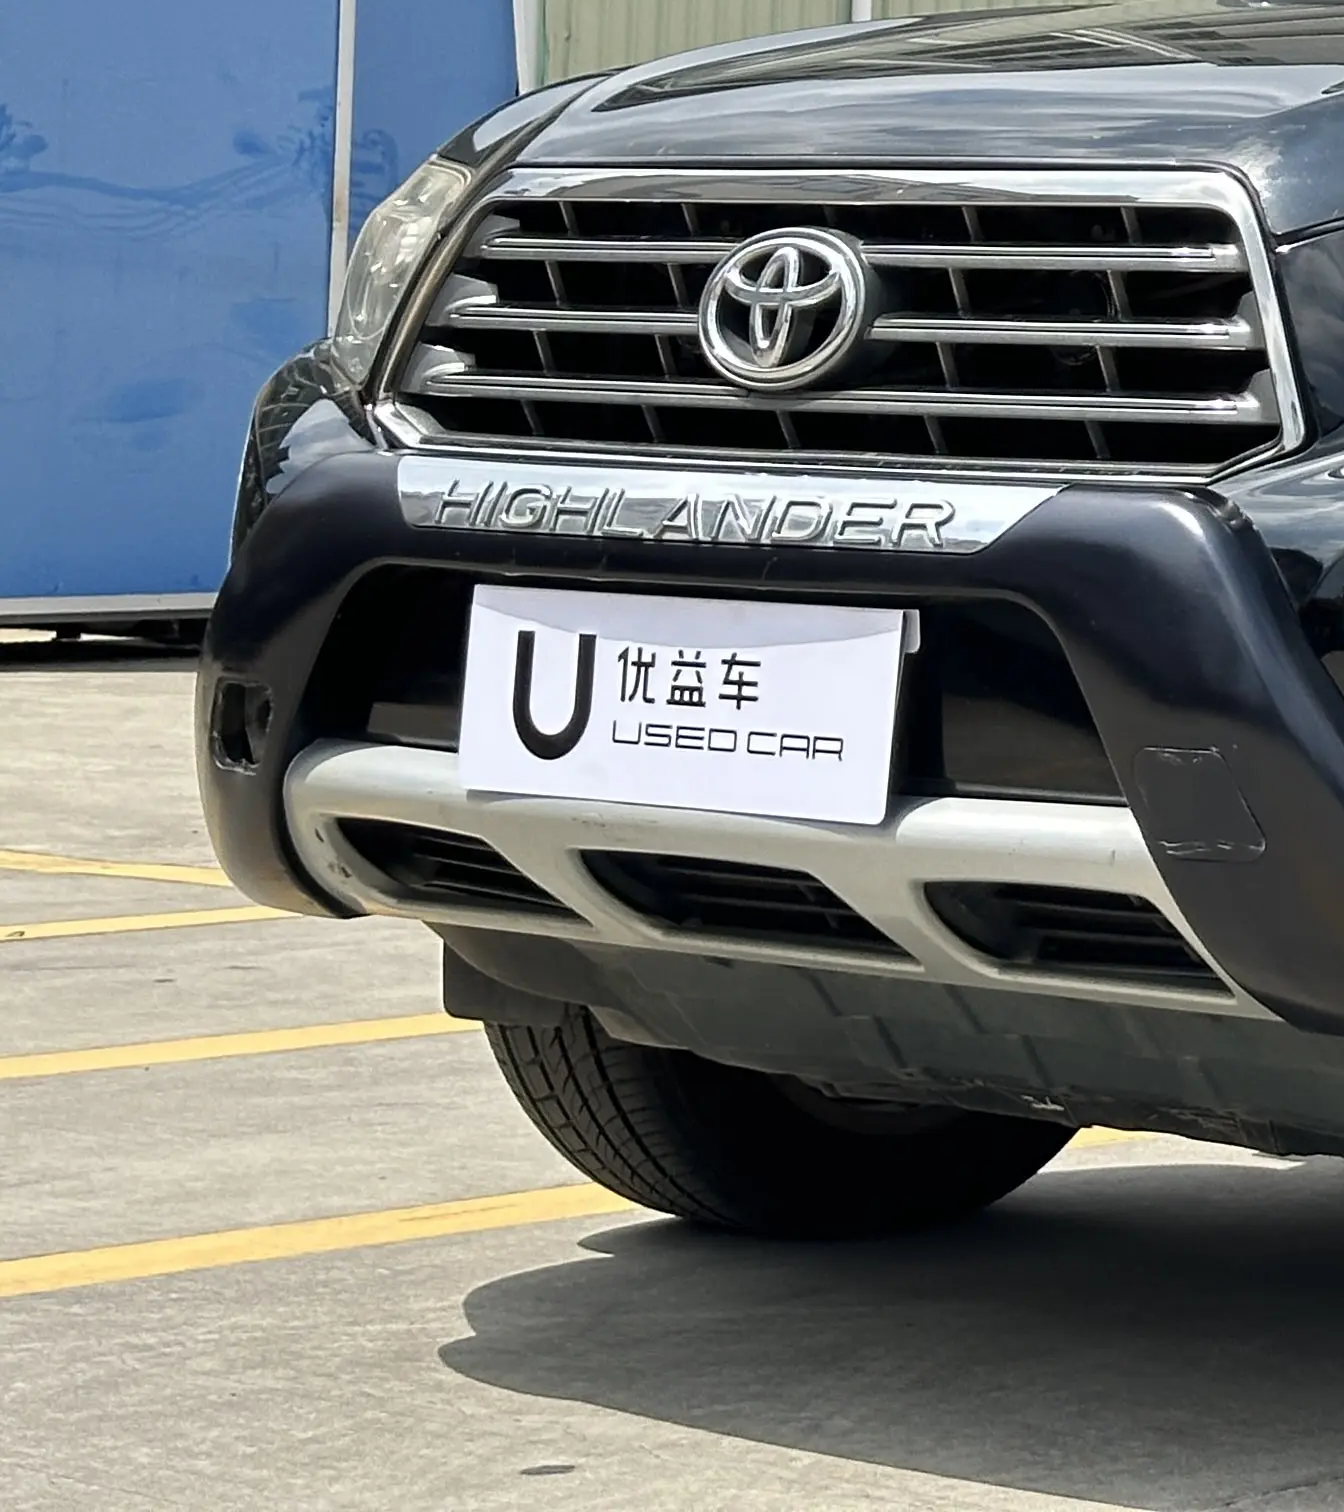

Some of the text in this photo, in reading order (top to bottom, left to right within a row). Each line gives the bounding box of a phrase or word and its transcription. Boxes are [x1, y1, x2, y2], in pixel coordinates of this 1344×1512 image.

[434, 479, 956, 549] HIGHLANDER
[512, 629, 598, 762] U
[617, 645, 762, 711] 优益车
[611, 719, 845, 762] USED CAR
